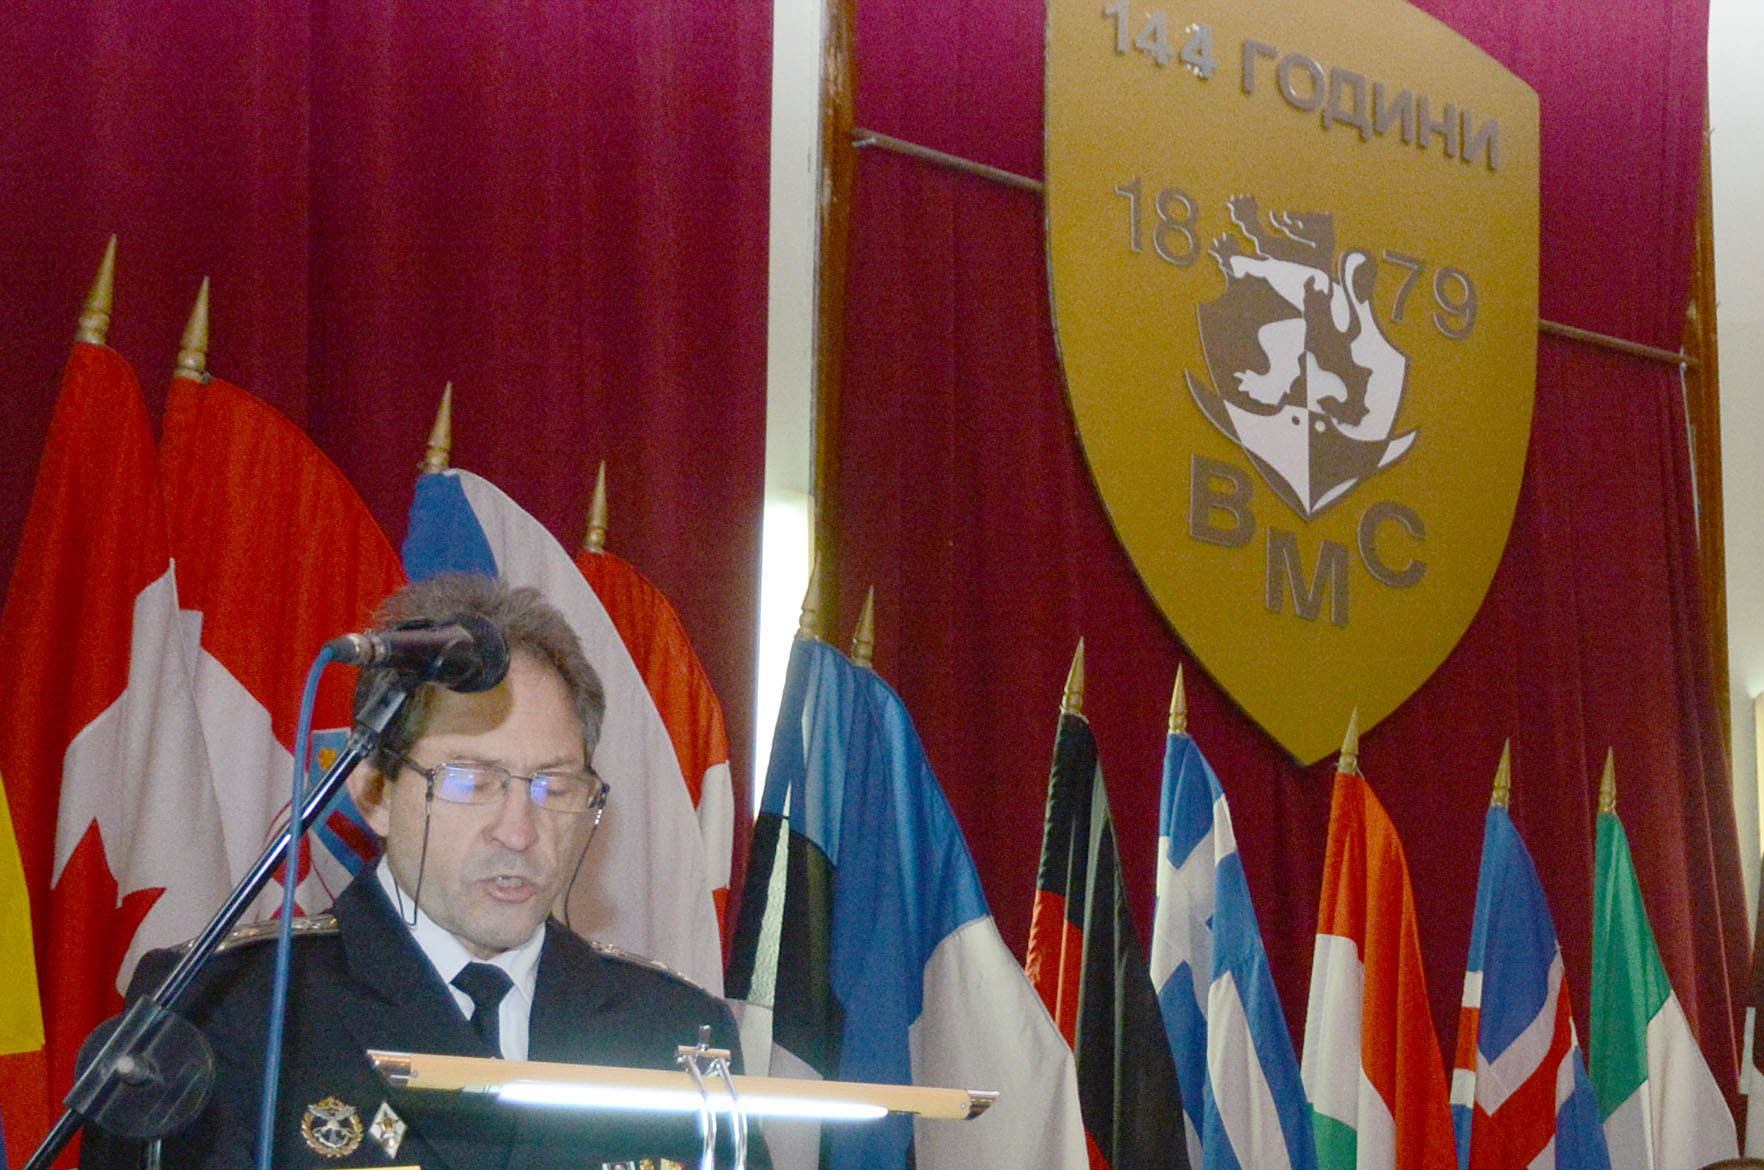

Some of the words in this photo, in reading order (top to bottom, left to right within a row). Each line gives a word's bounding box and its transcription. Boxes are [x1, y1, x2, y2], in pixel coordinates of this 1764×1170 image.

[1104, 0, 1219, 80] 144
[1242, 38, 1499, 172] ГОДИНИ
[1115, 177, 1200, 266] 18
[1383, 249, 1477, 338] 79
